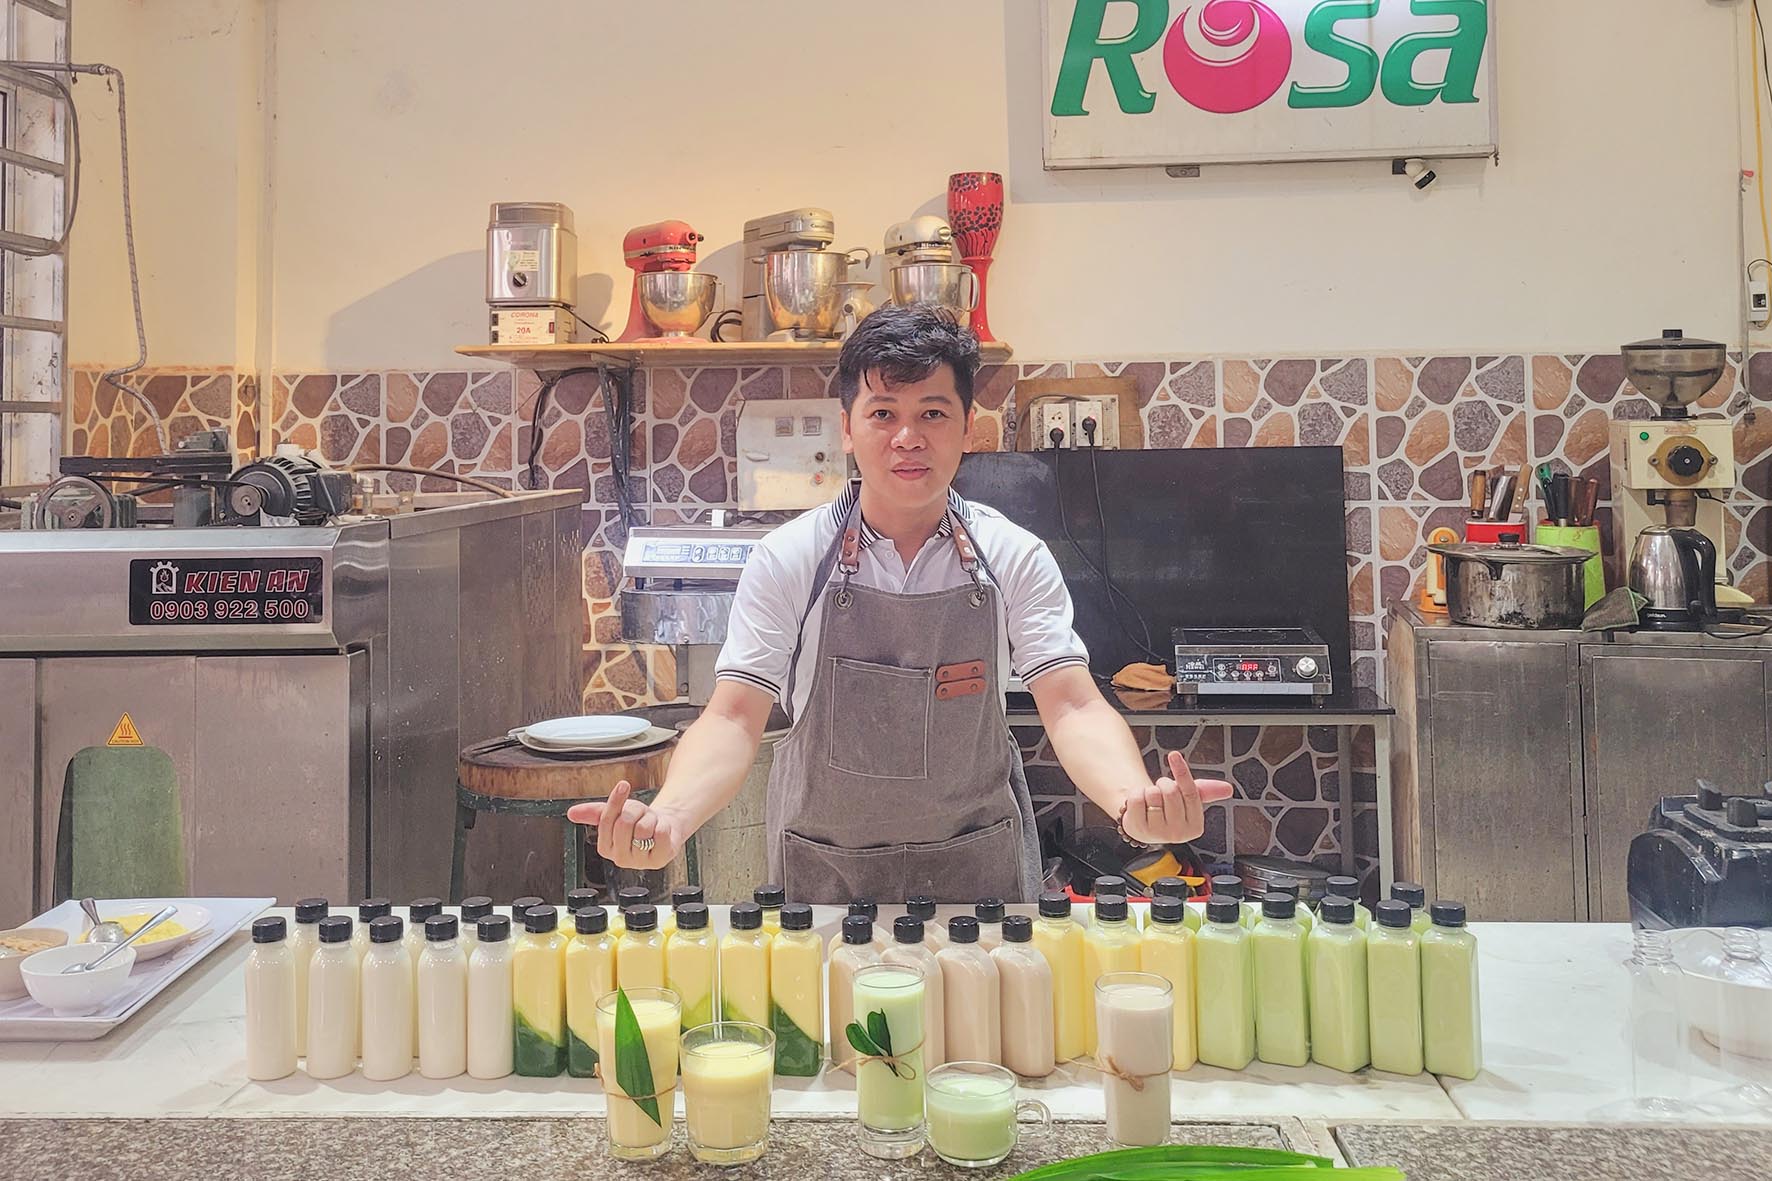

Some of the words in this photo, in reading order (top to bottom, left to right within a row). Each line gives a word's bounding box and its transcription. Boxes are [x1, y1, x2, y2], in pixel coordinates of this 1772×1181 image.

[184, 569, 261, 593] KIEN
[265, 569, 310, 593] AN
[150, 600, 208, 620] 0903
[214, 600, 258, 619] 922
[264, 599, 309, 619] 500
